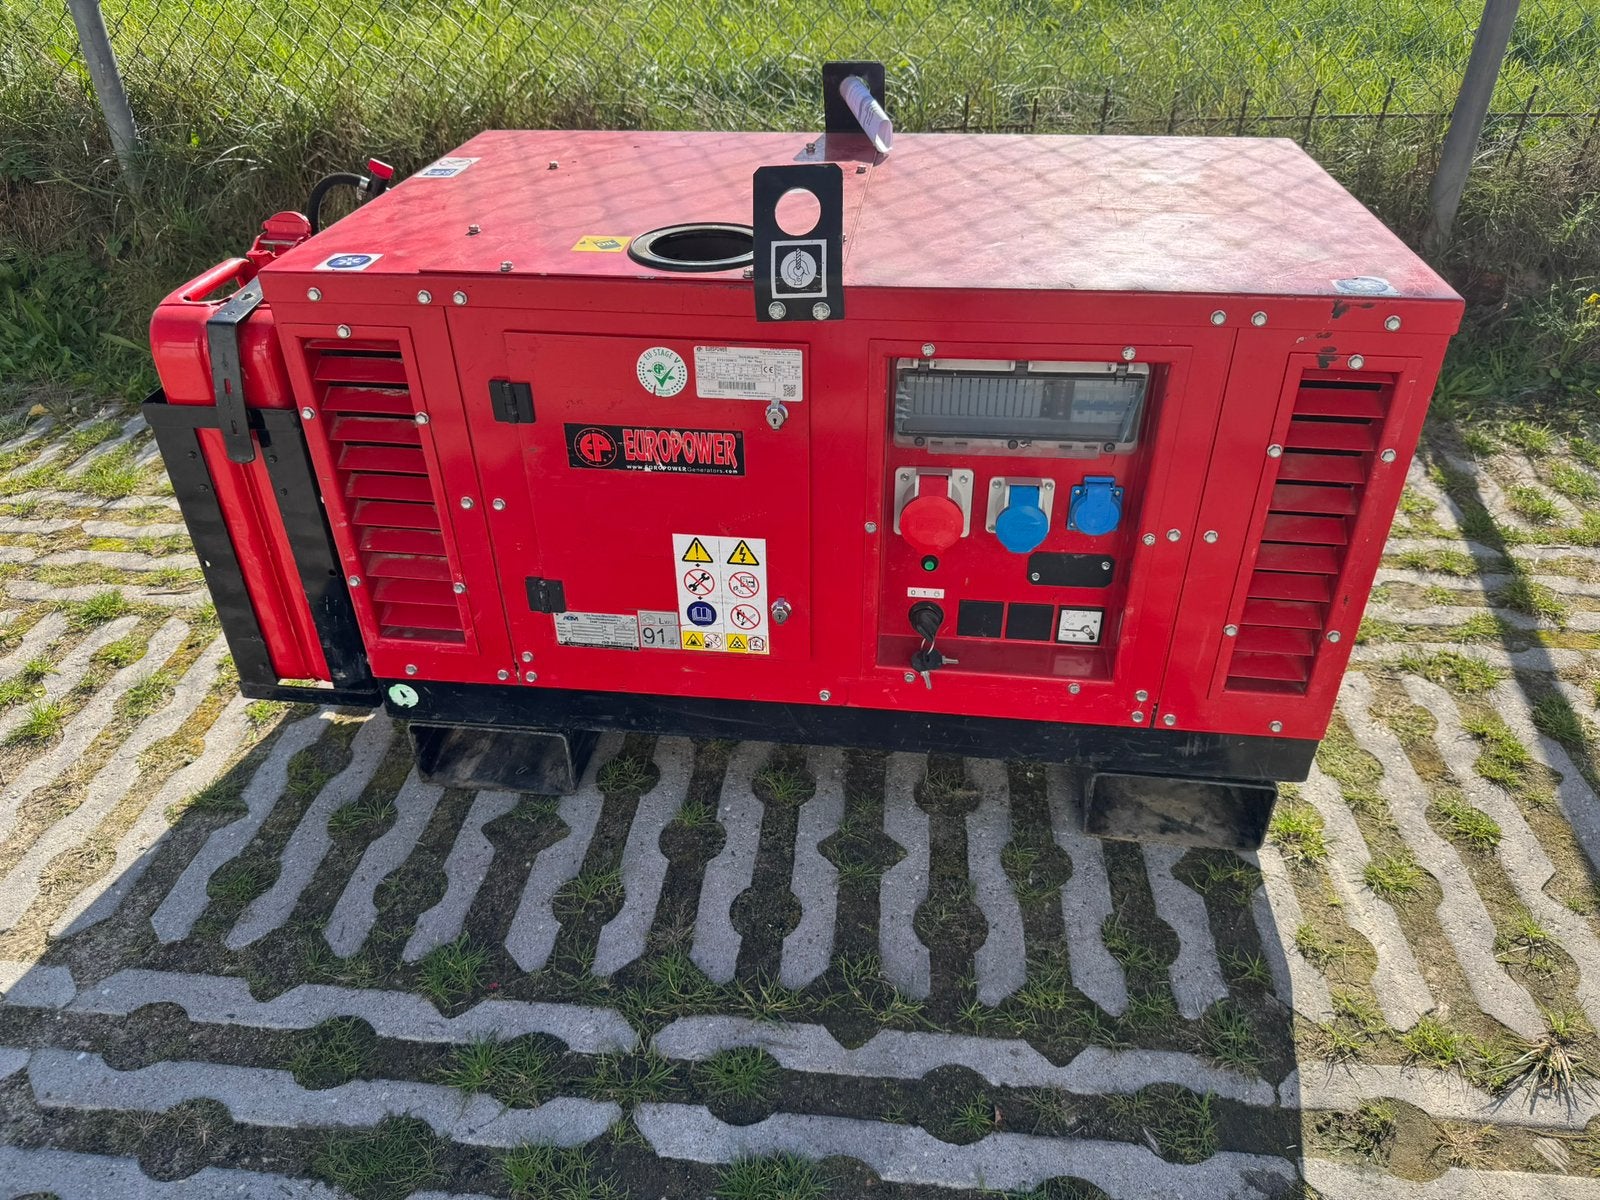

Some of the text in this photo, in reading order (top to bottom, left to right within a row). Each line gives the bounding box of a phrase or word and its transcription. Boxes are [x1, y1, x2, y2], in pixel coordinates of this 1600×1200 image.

[643, 351, 653, 361] EU
[653, 348, 673, 359] STAGE
[622, 428, 738, 469] EUROPOWER
[643, 627, 665, 645] 91
